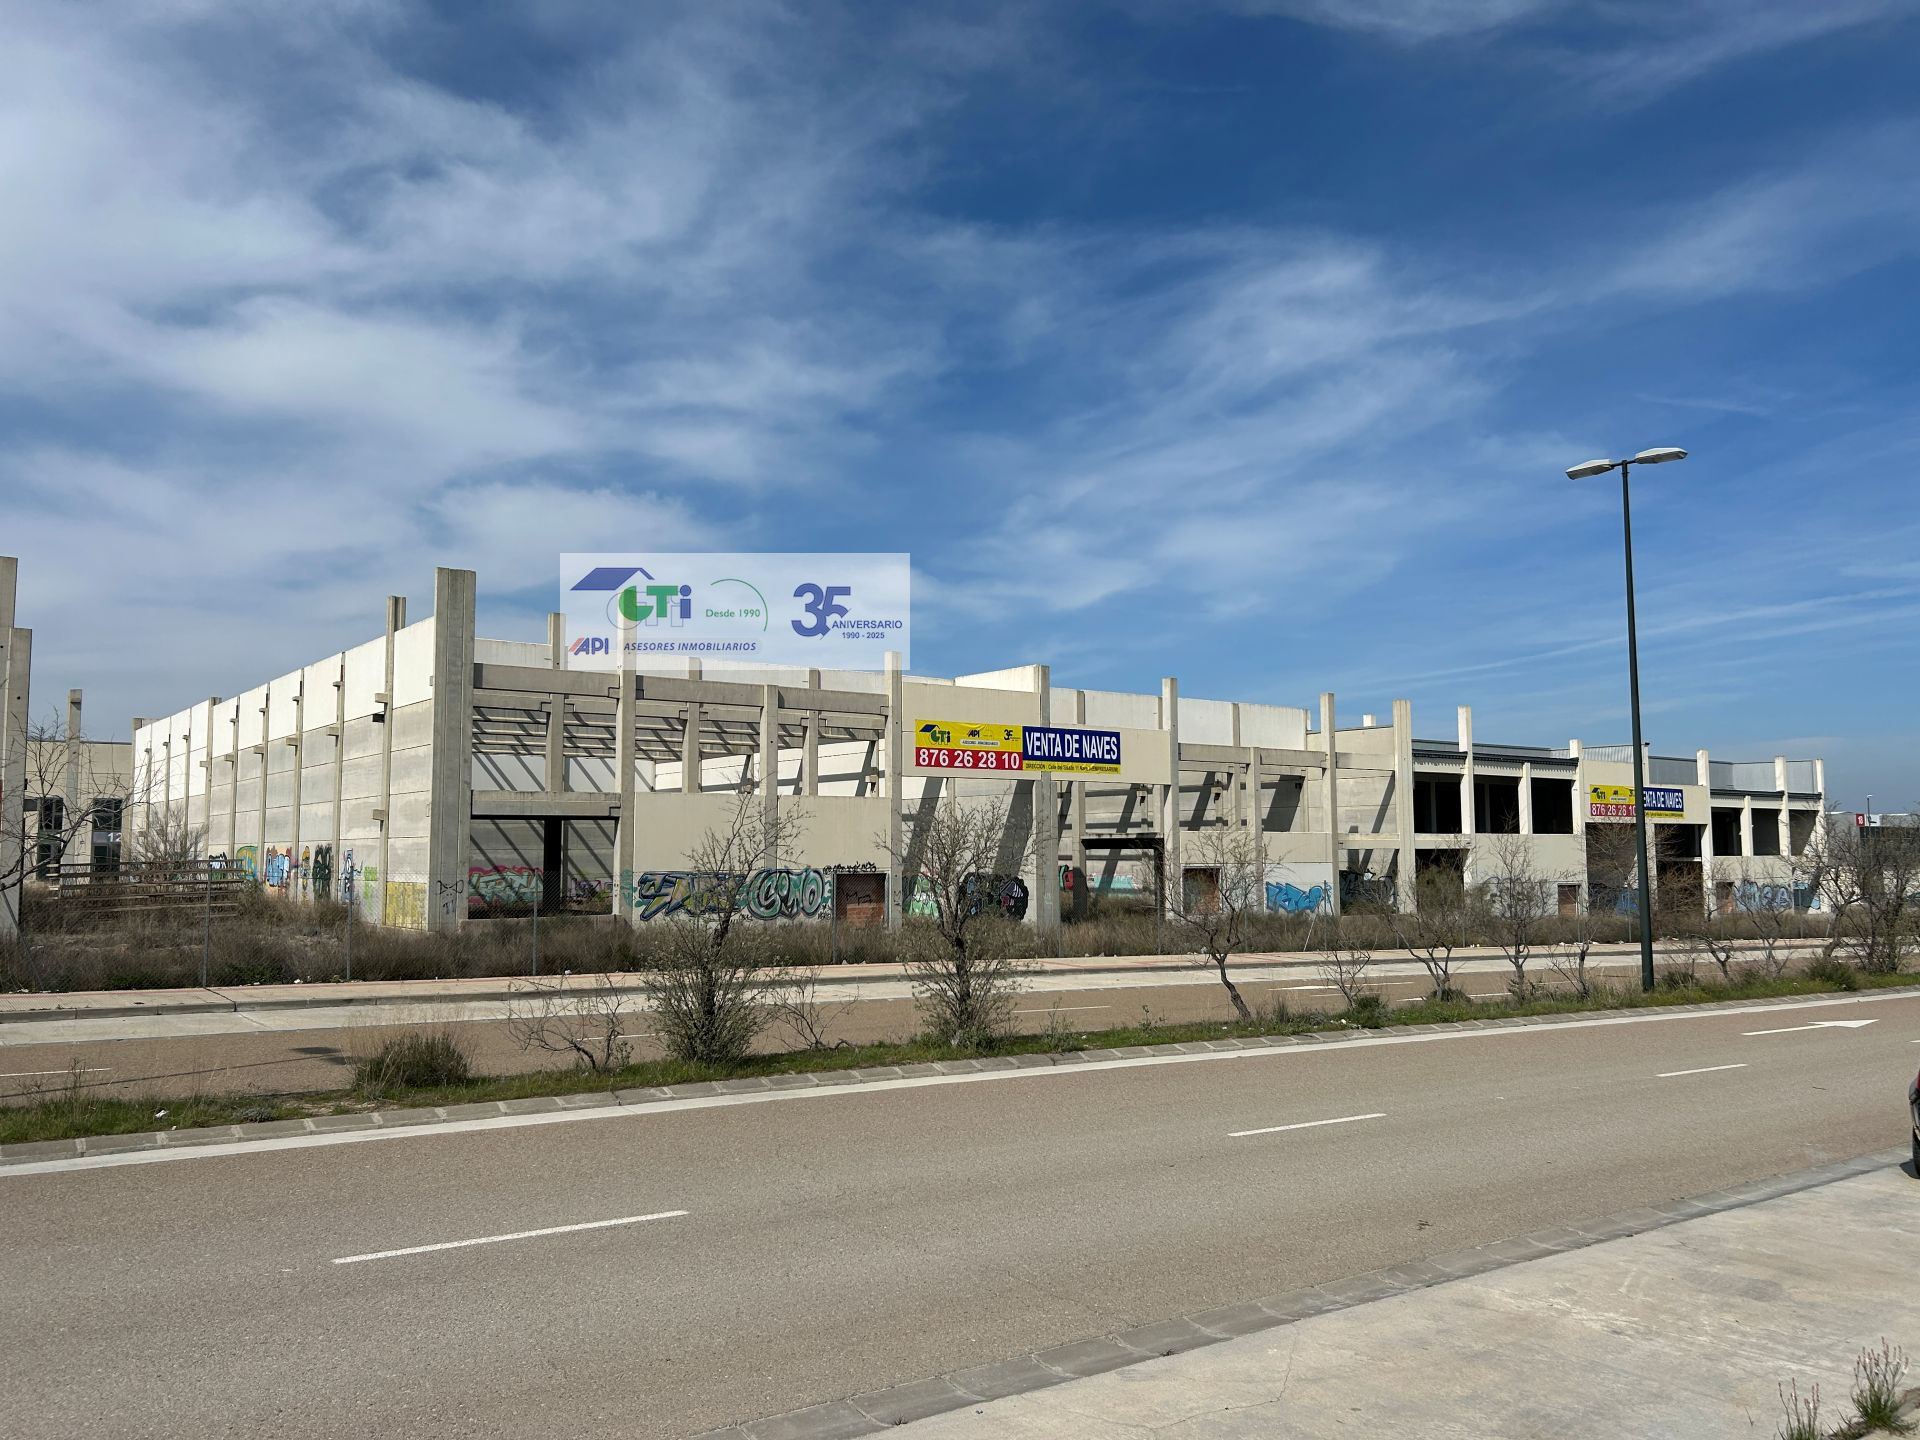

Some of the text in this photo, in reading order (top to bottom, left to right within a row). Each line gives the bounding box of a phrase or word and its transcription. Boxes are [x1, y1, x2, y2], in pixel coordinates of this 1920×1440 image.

[1026, 732, 1118, 760] VENTA DE NAVES
[919, 748, 1020, 769] 876 26 28 10
[1643, 791, 1683, 809] ENTA DE NAVES
[1592, 804, 1606, 815] 876
[1607, 805, 1616, 816] 26
[1618, 805, 1627, 816] 28
[107, 832, 122, 842] 12
